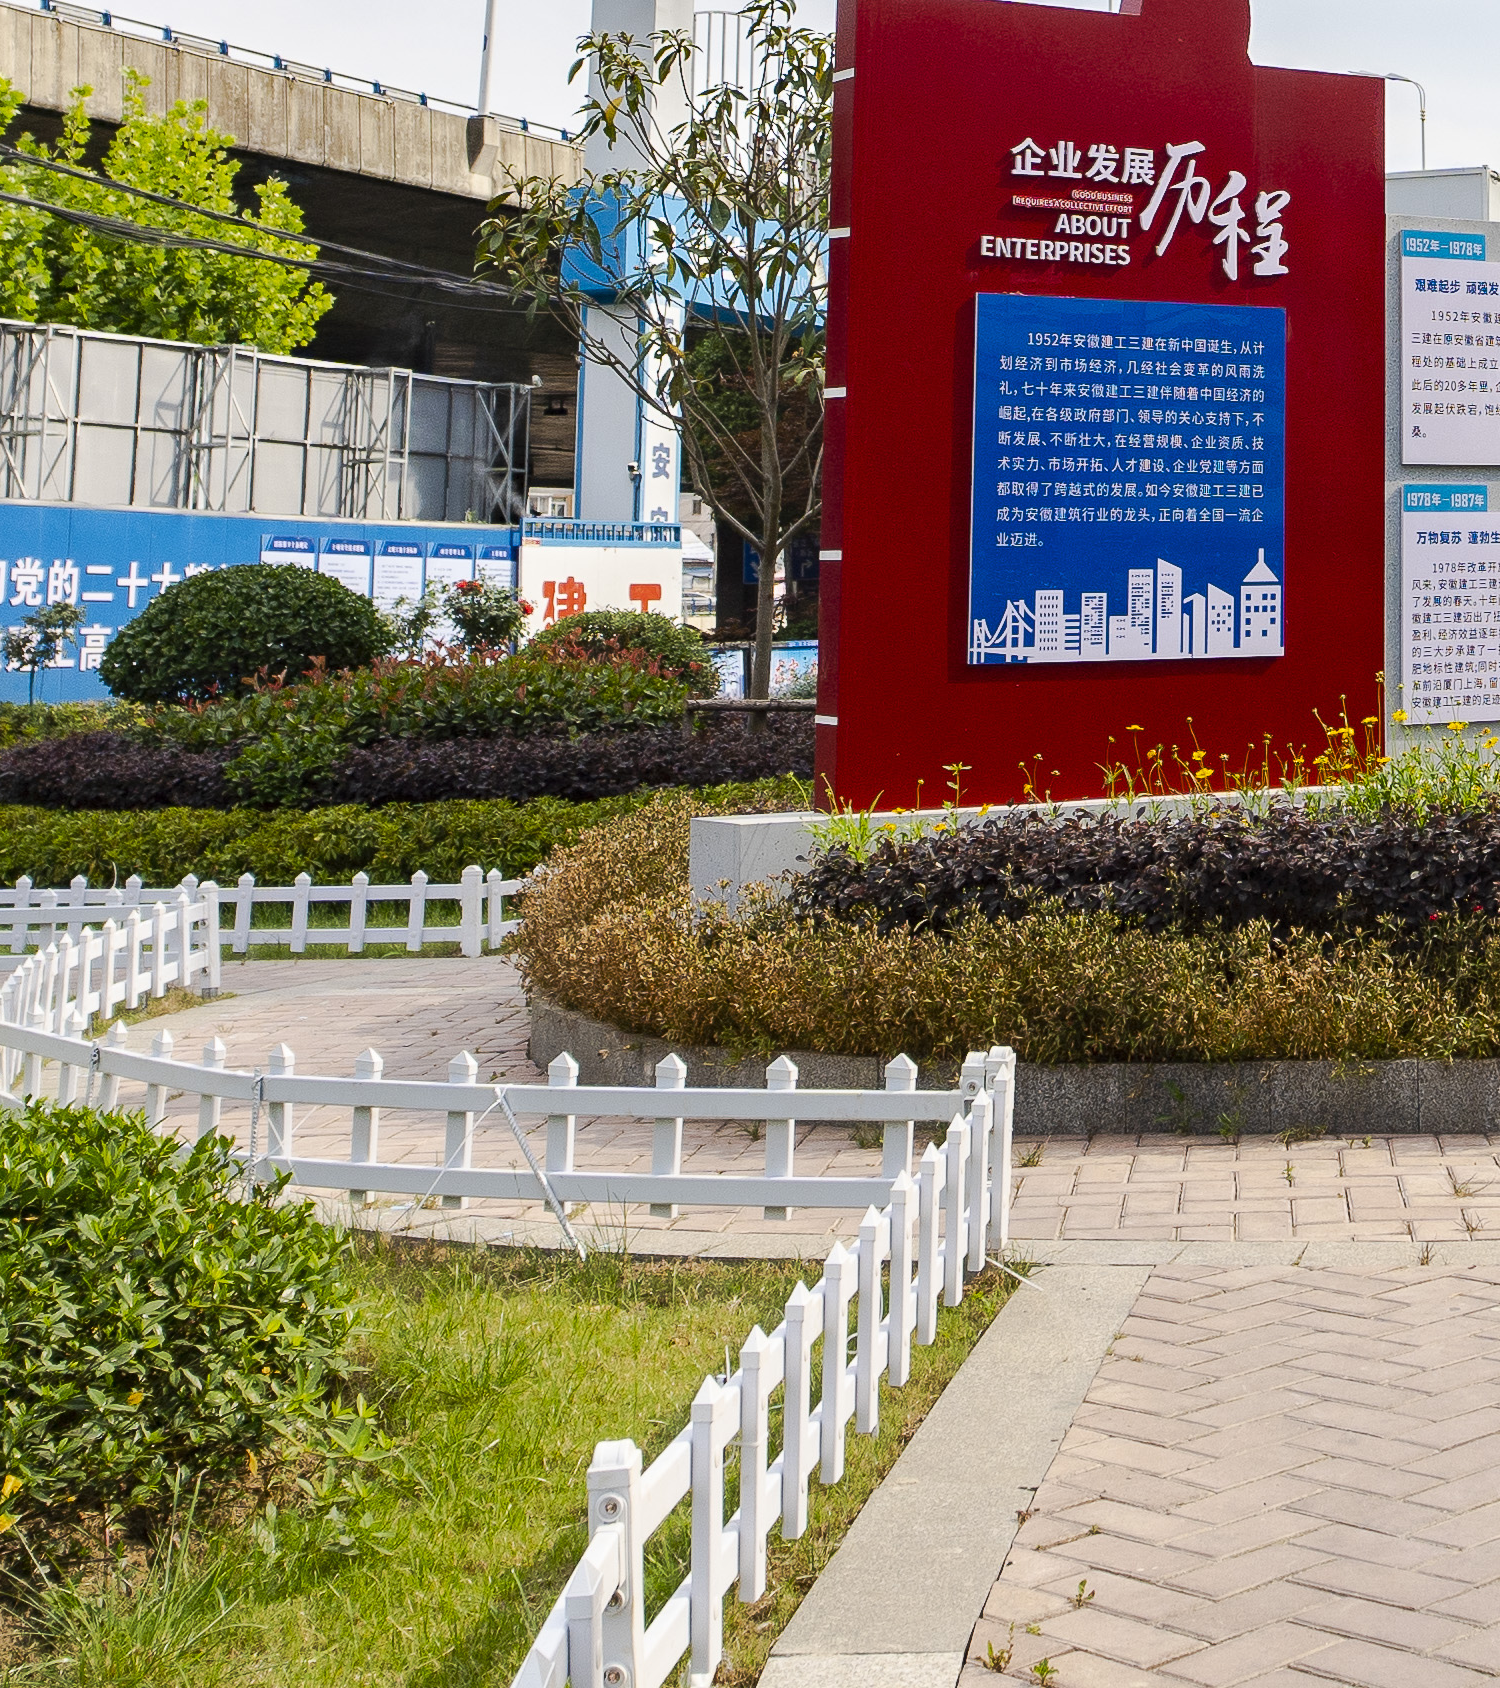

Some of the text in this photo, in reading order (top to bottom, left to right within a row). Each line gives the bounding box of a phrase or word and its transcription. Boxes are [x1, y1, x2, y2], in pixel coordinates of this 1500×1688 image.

[1097, 191, 1133, 203] BUSINESS
[1011, 137, 1291, 281] 企业发展 历程
[1060, 200, 1104, 211] COLLECTIVE
[1105, 203, 1132, 214] EFFORT
[1054, 214, 1131, 238] ABOUT
[981, 236, 1131, 265] ENTERPRISES
[1415, 279, 1460, 293] 艰难起步
[1416, 531, 1461, 544] 万物复苏
